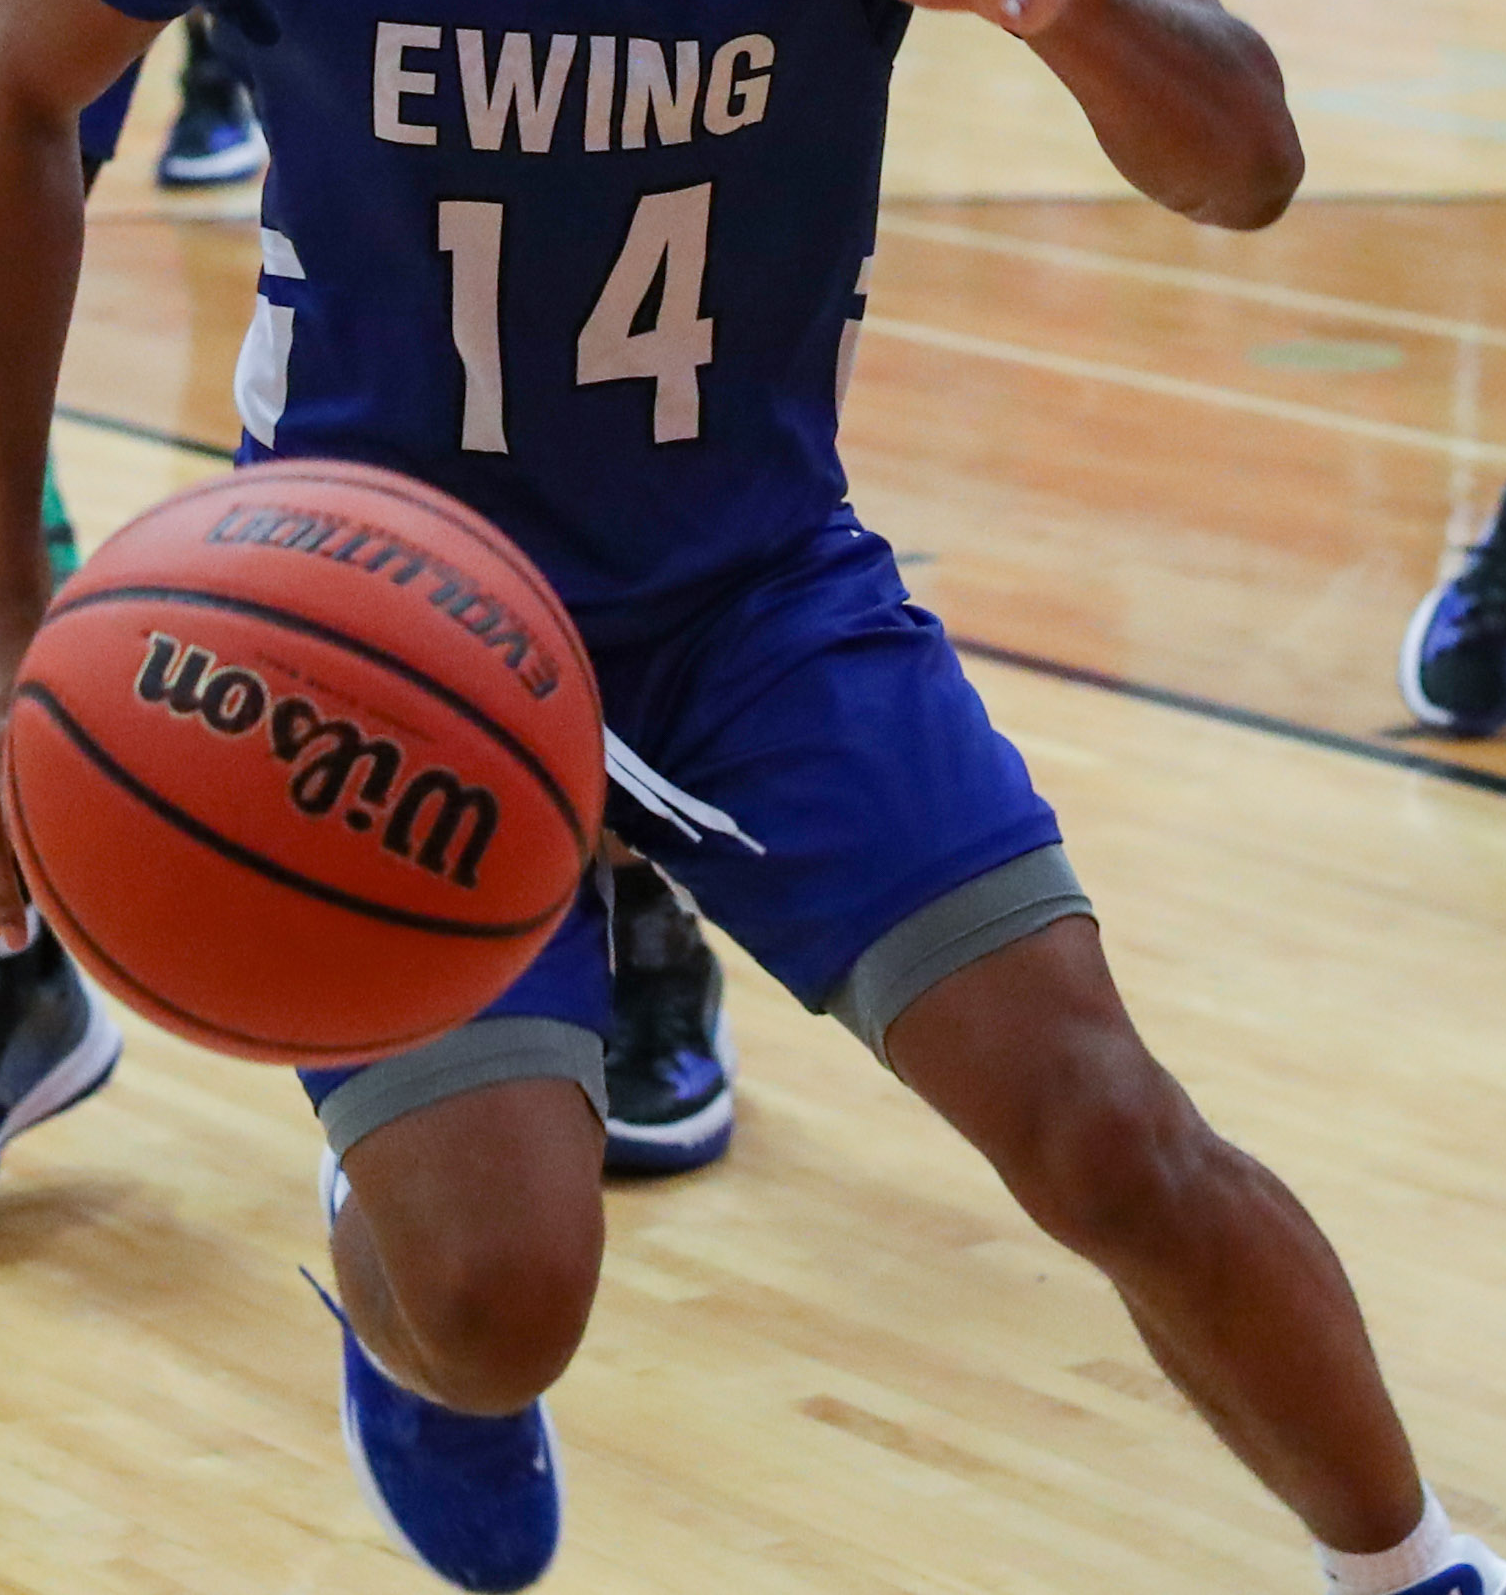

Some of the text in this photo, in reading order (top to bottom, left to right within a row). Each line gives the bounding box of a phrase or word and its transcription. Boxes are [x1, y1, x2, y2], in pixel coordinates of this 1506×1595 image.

[372, 21, 777, 153] EWING
[436, 181, 714, 455] 14
[207, 503, 561, 701] EVOLUTION
[133, 630, 502, 891] Wilson
